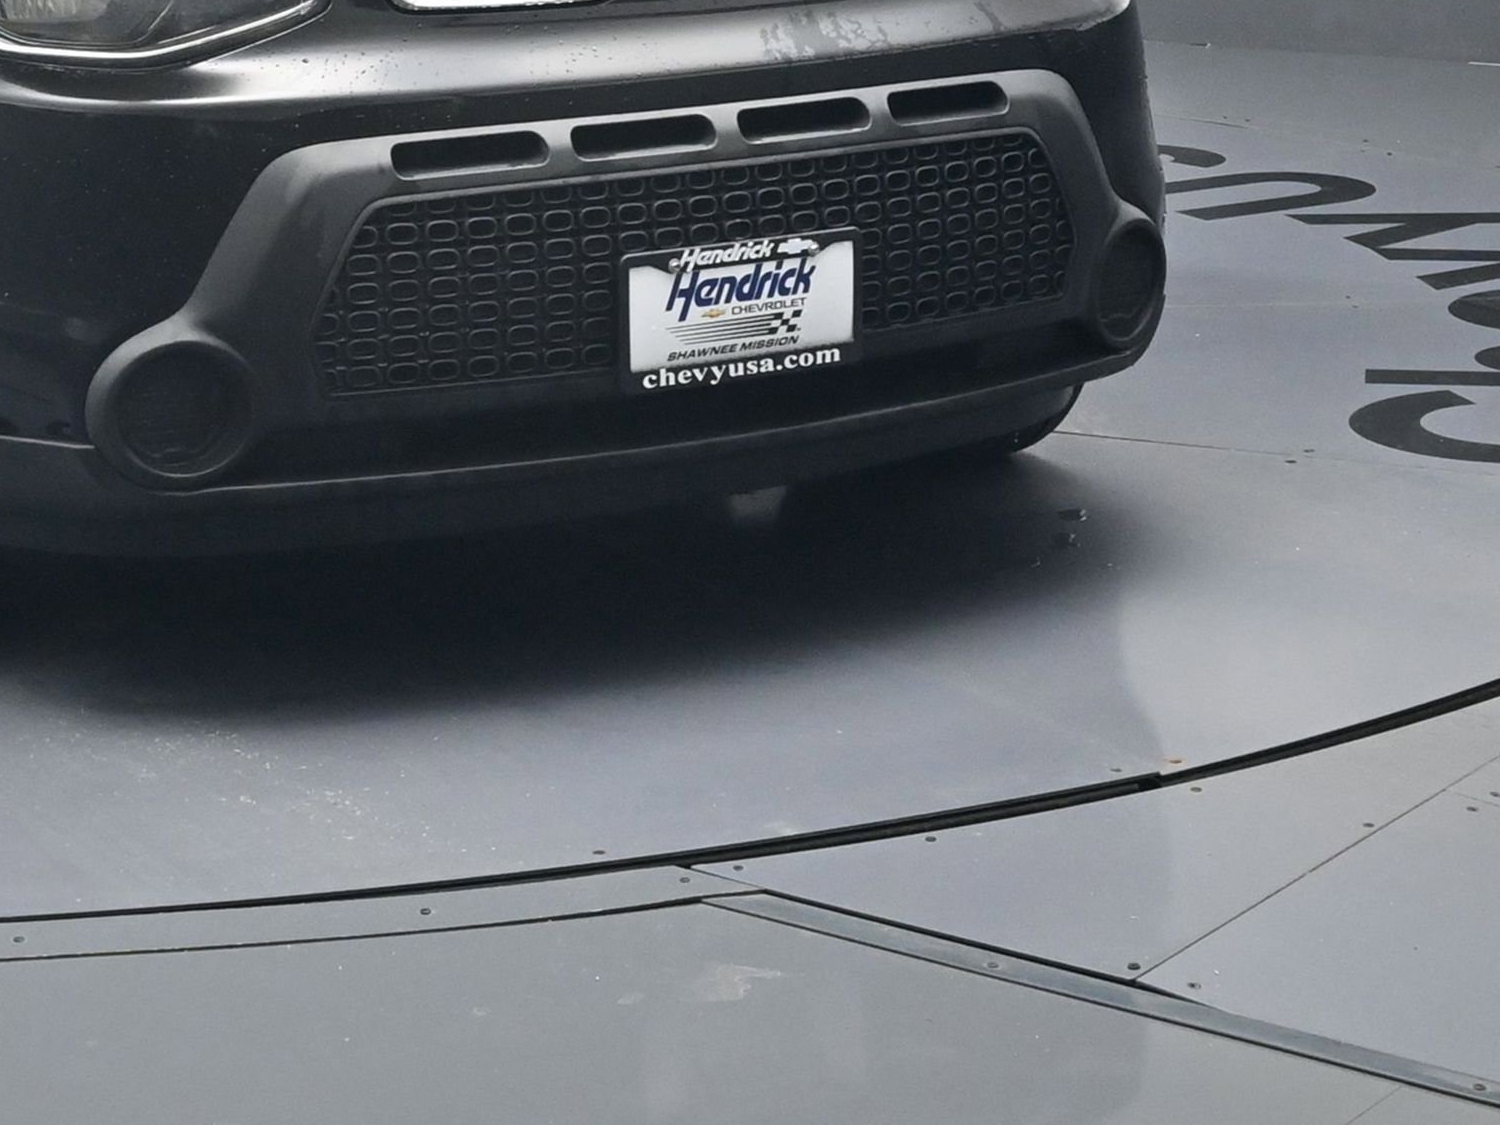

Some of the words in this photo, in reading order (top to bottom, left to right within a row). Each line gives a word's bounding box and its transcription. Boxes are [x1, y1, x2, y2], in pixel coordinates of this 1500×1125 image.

[679, 239, 774, 273] Hendrick
[665, 256, 816, 323] Hendrick
[730, 296, 808, 316] CHEVROLET
[667, 342, 738, 362] SHAWNEE
[739, 334, 801, 352] MISSION
[642, 346, 842, 390] chevyusa.com
